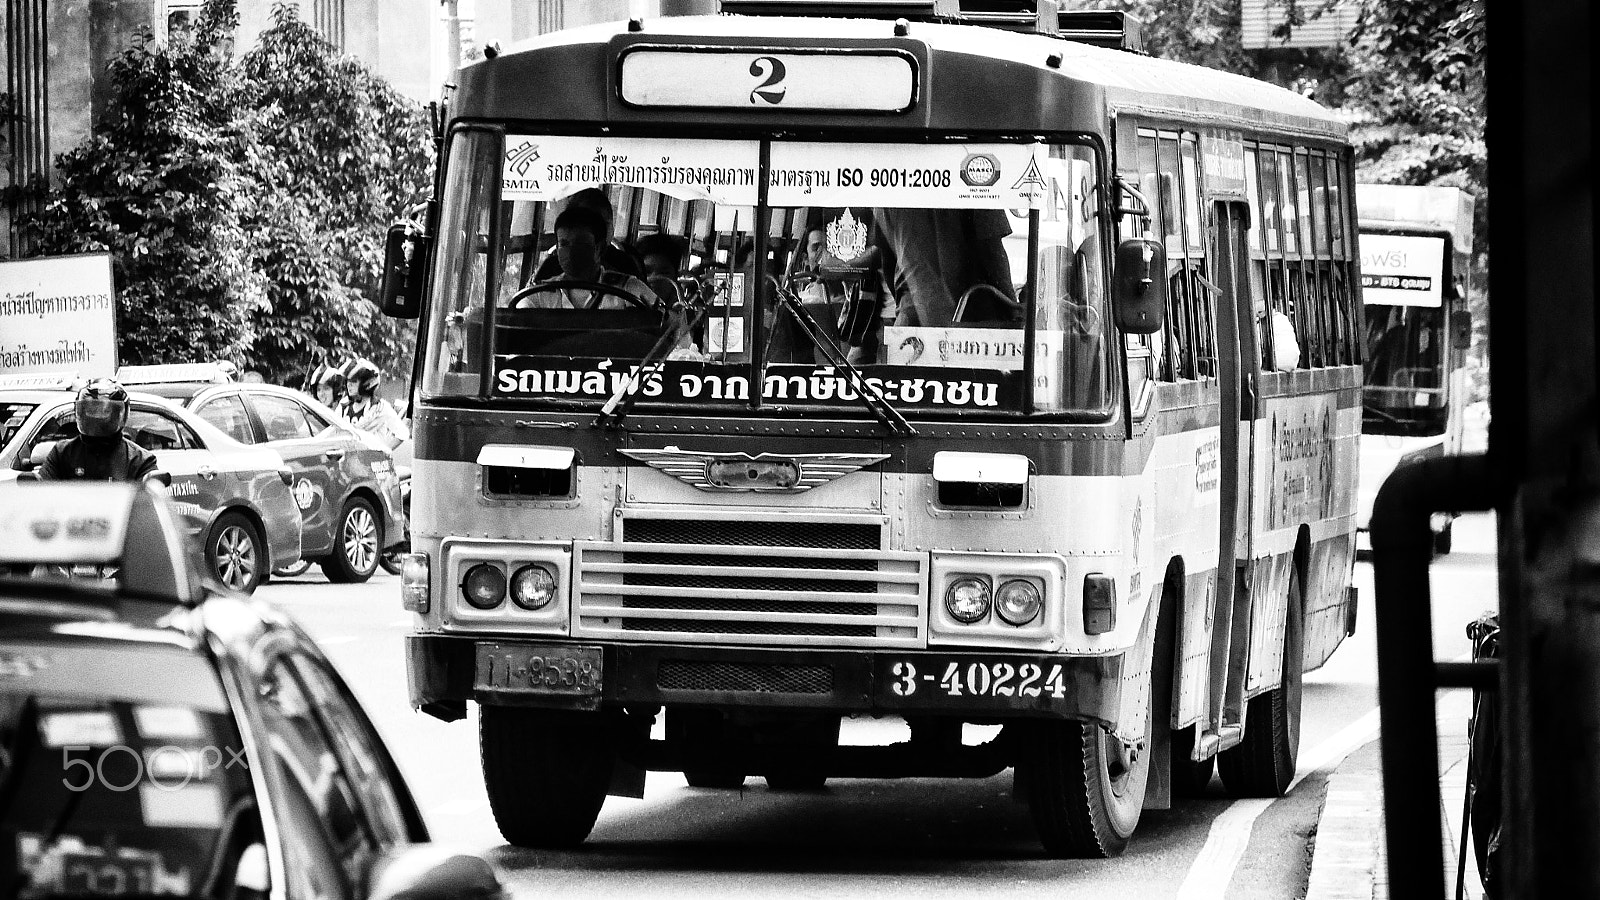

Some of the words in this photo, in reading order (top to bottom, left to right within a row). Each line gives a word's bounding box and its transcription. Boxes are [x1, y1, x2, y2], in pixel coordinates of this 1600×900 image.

[749, 56, 786, 105] 2
[502, 179, 540, 189] BMTA
[546, 146, 755, 194] รถสายนี้ได้รับการรับรองคุณภาพ
[769, 166, 831, 195] มาตรฐาน
[836, 168, 864, 187] ISO
[870, 168, 951, 188] 9001:2008
[497, 357, 665, 397] รถเมล์ฟรี
[679, 374, 750, 400] จาก
[762, 365, 998, 406] ภาษีประชาชน
[892, 662, 1066, 699] 3-40224
